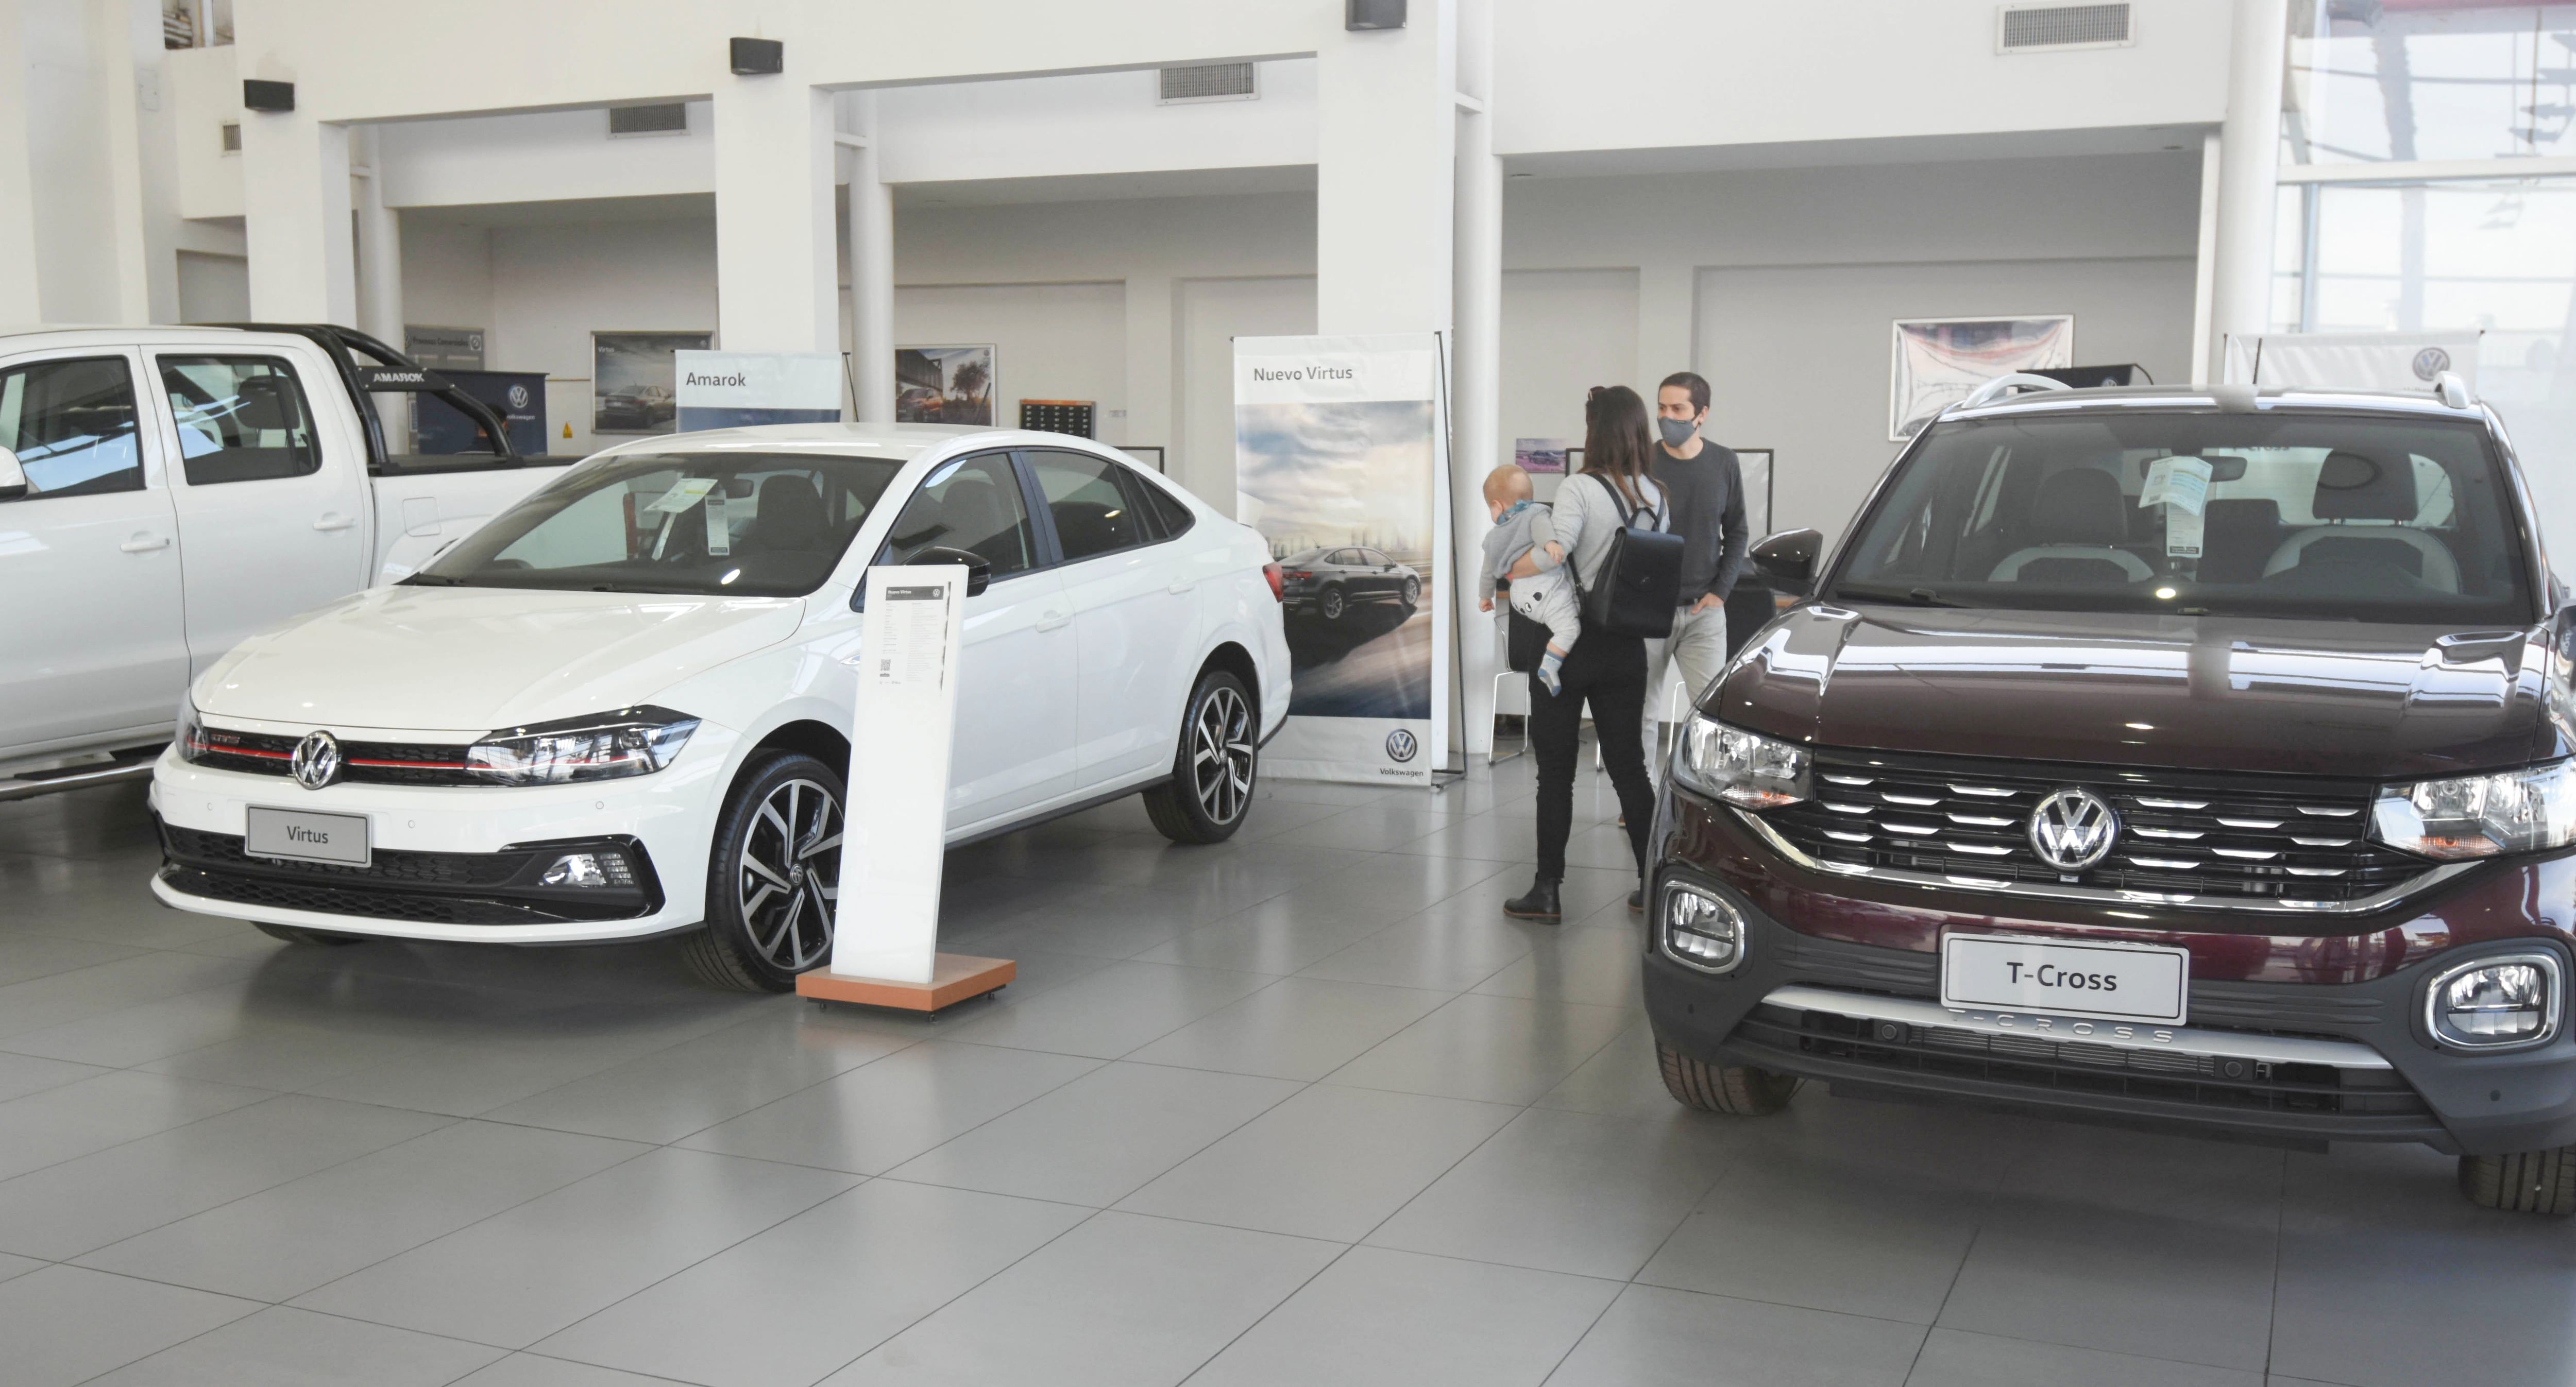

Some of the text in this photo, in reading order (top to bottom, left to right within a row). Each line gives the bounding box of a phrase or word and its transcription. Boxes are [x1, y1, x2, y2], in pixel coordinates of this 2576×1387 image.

[374, 373, 425, 382] AMAROK
[686, 372, 746, 386] Amarok
[1254, 366, 1352, 381] Nuevo Virtus
[1380, 768, 1423, 778] Volkswagen
[287, 826, 328, 844] Virtus
[2007, 962, 2117, 991] T-Cross
[1948, 1009, 2173, 1043] T-CROSS
